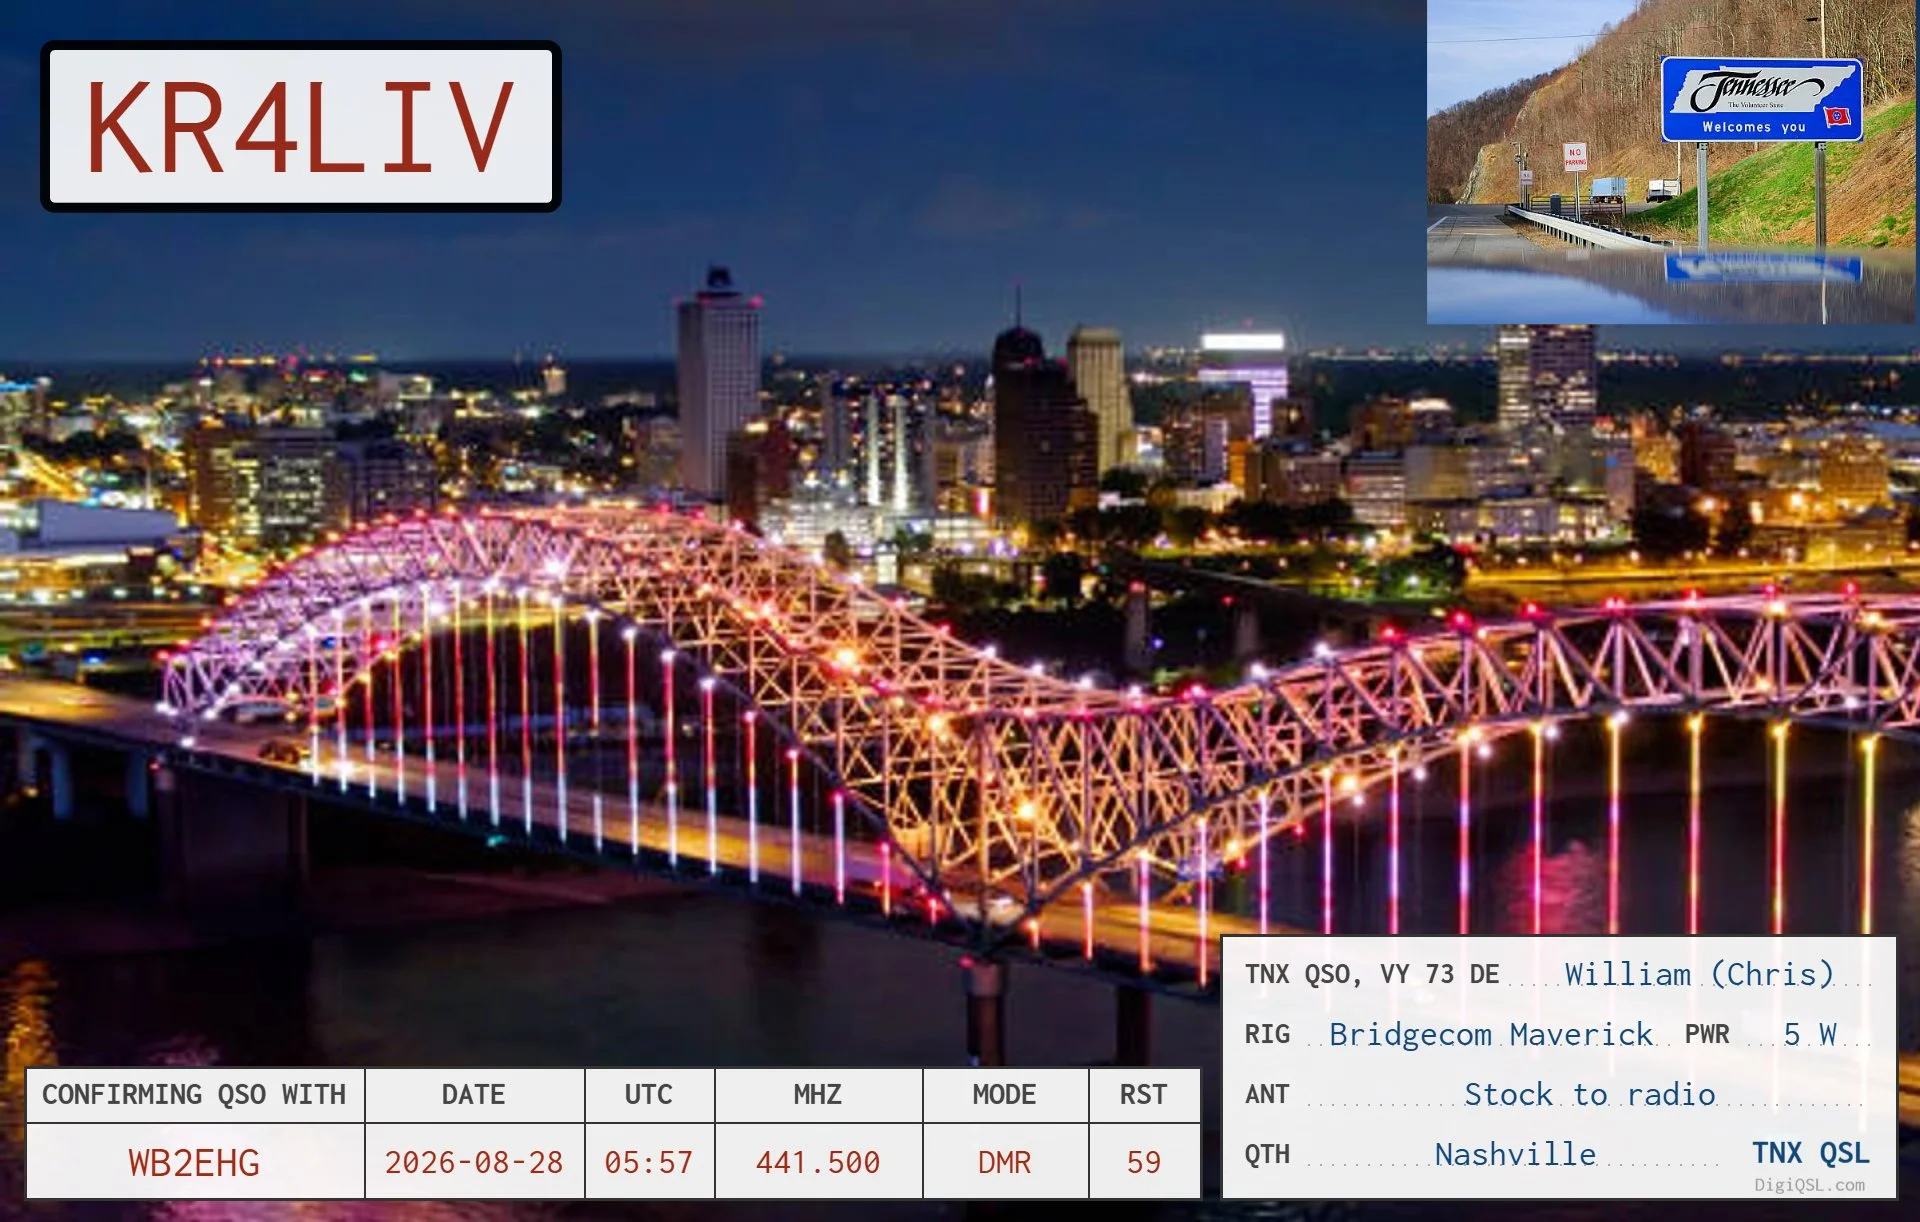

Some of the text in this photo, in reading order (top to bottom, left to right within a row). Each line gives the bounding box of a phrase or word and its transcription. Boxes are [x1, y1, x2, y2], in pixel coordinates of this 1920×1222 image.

[1690, 70, 1825, 113] Tennessee
[1702, 121, 1806, 135] Welcomes you
